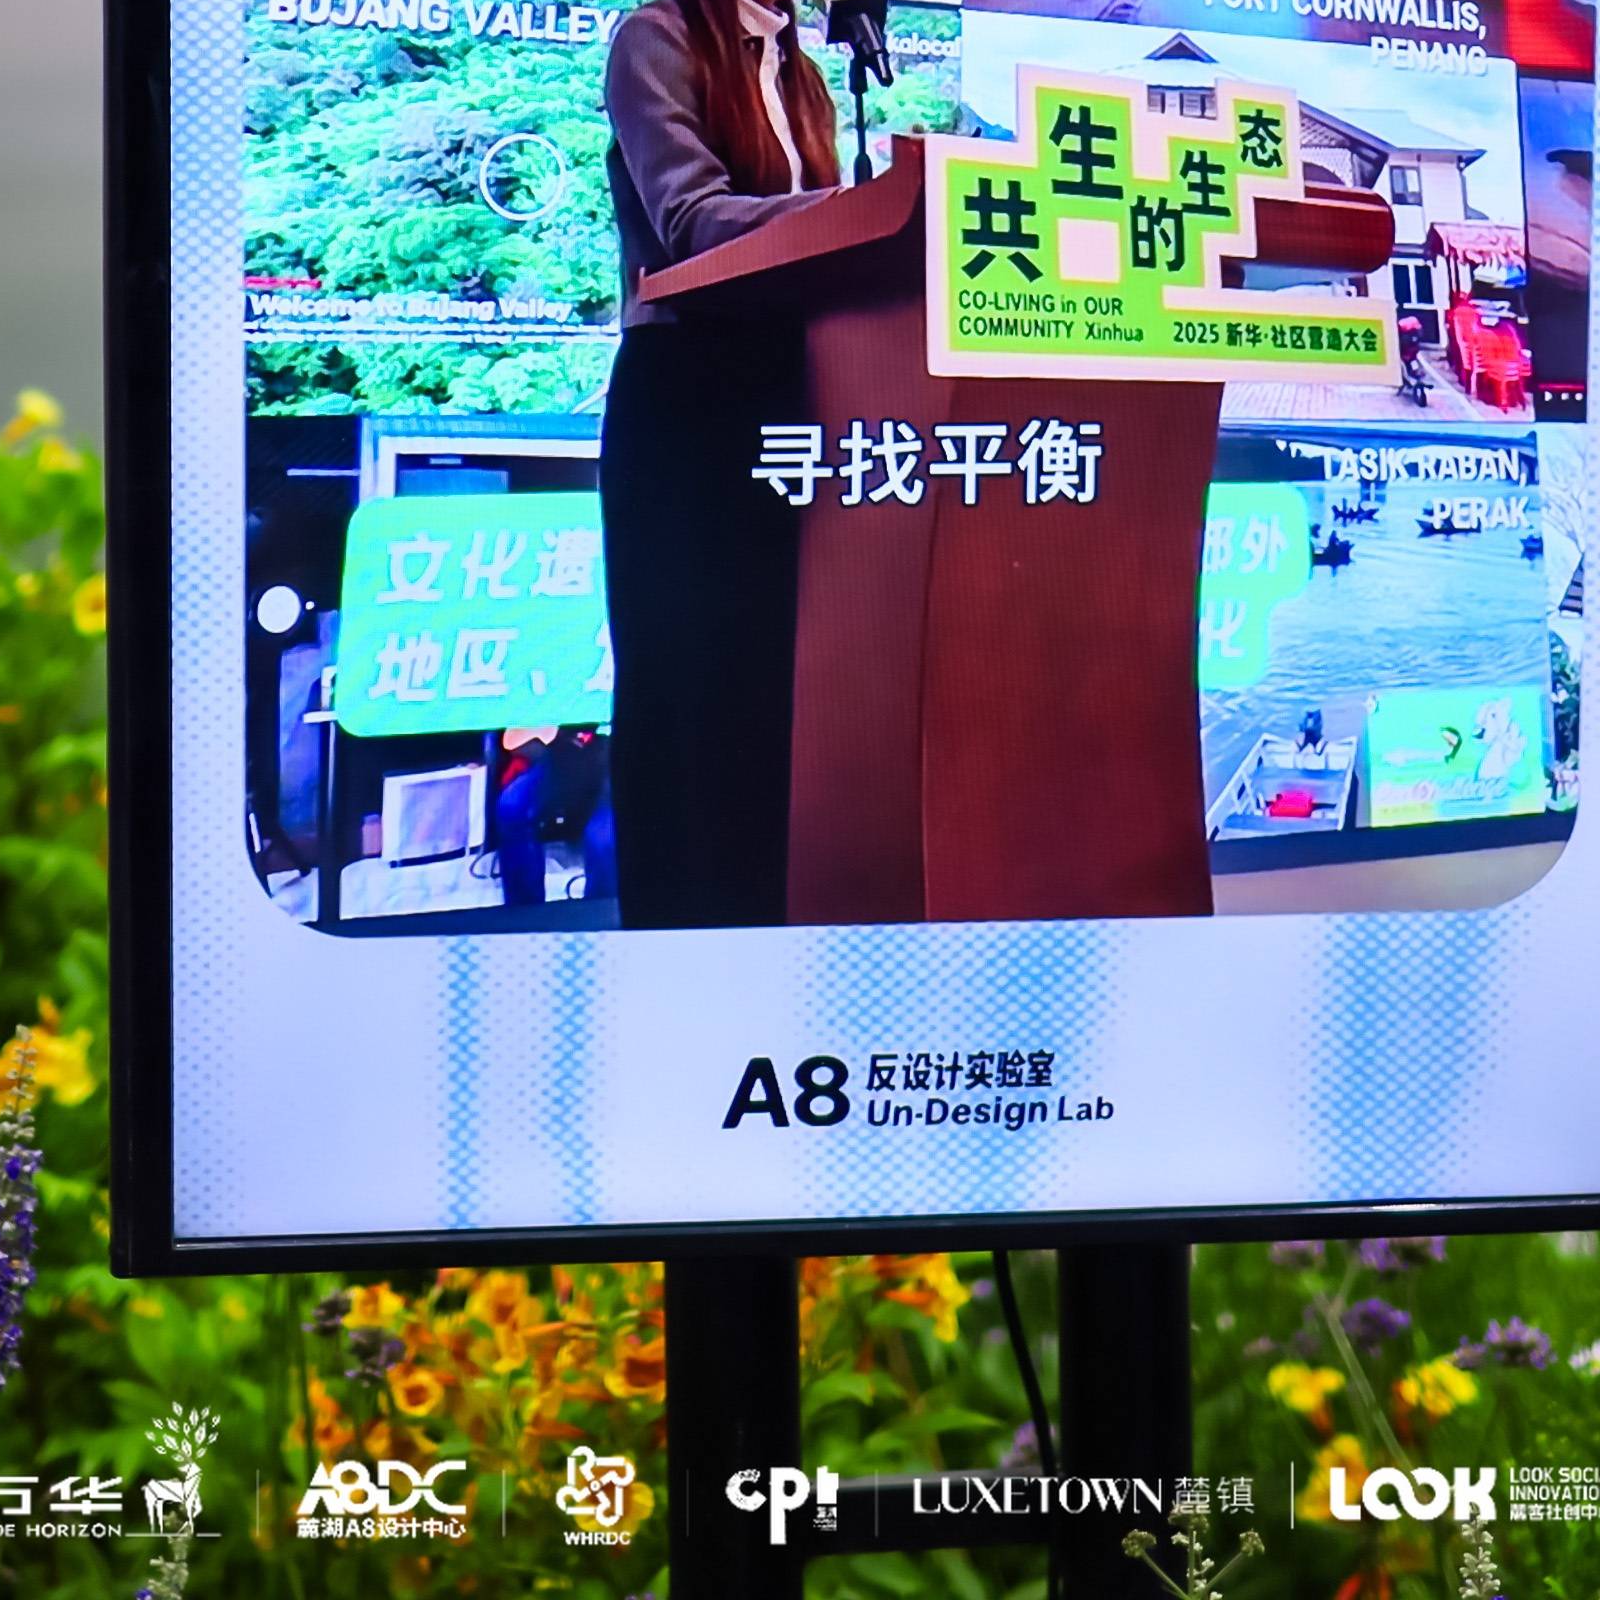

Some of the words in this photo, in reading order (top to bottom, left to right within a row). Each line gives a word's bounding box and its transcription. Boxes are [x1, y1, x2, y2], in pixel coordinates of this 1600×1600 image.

[1370, 36, 1488, 76] PENANG
[958, 289, 1055, 314] CO-LIVING
[1060, 294, 1077, 315] in
[1083, 296, 1123, 316] OUR
[958, 315, 1074, 339] COMMUNITY
[1084, 319, 1144, 343] Xinhua
[1172, 321, 1220, 344] 2025
[751, 419, 1104, 507] 寻找平衡
[1417, 446, 1527, 487] RABAN,
[1431, 496, 1529, 530] PERAK
[721, 1054, 852, 1129] A8
[866, 1049, 1055, 1092] 反设计实验室
[866, 1096, 1048, 1131] Un-Design
[1057, 1095, 1114, 1122] Lab
